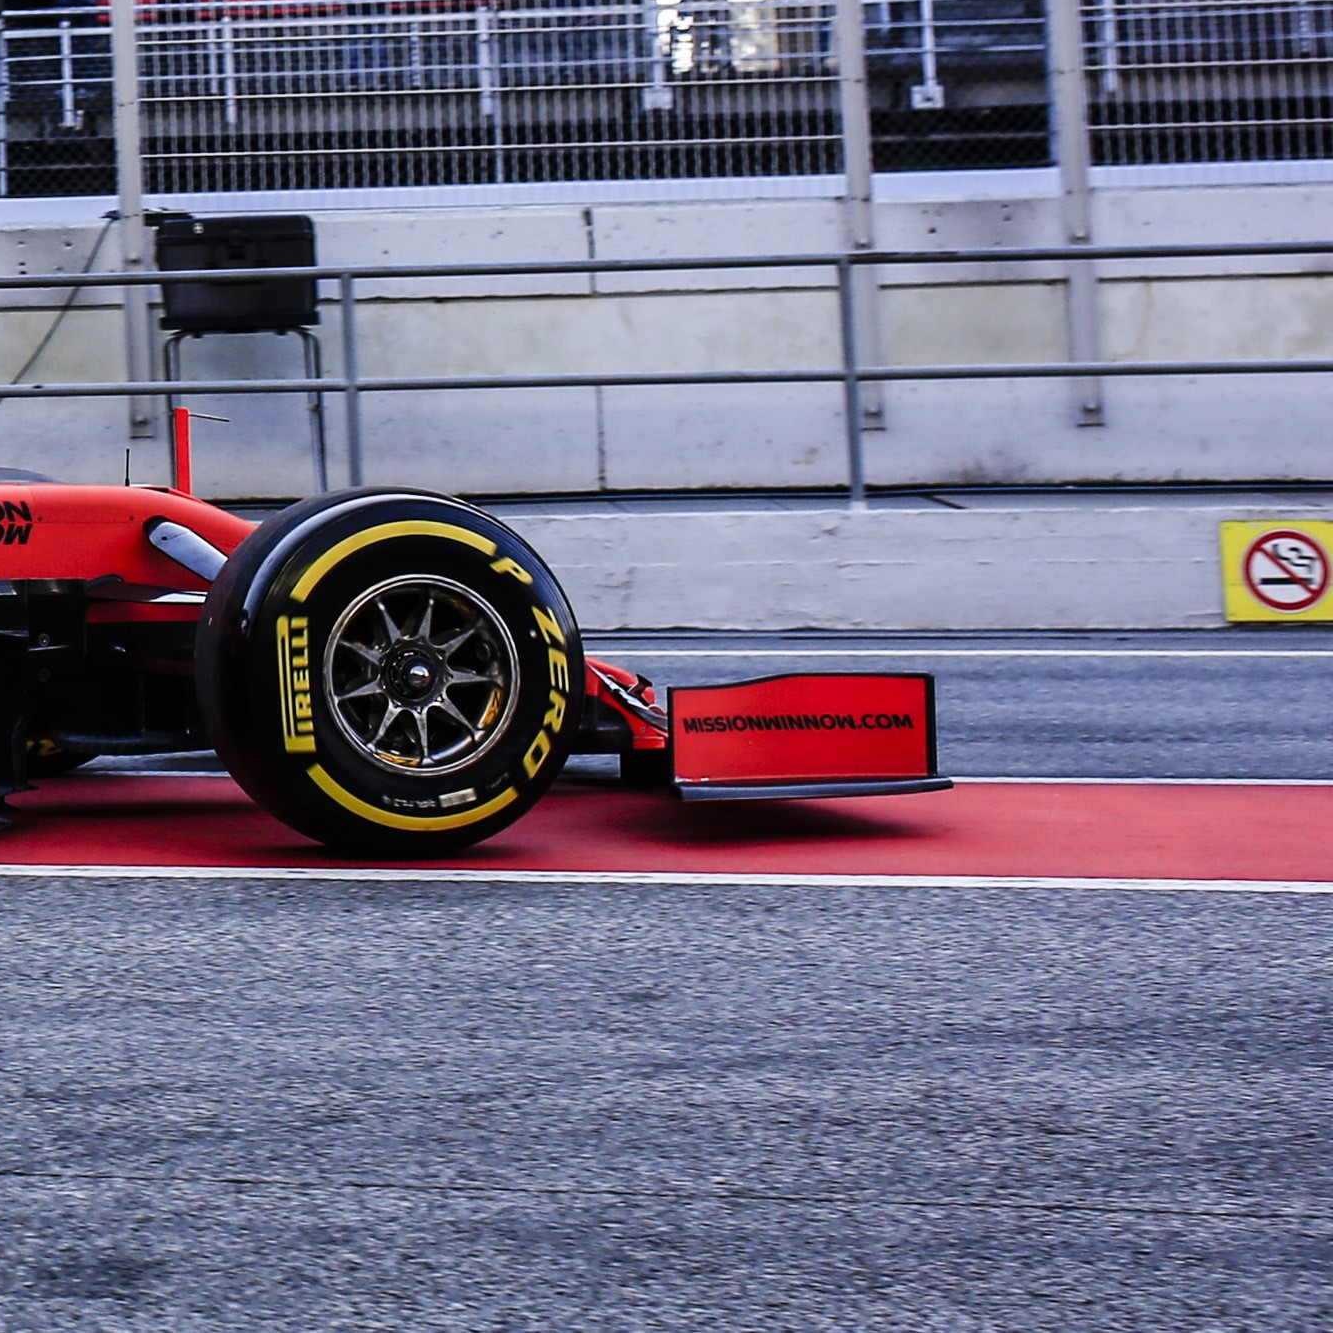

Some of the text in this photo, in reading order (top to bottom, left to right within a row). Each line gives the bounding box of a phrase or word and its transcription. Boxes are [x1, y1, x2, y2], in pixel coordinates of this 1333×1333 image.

[275, 614, 318, 754] PIRELLI
[522, 604, 572, 780] ZERO
[681, 713, 915, 735] MISSIONWINNOW.COM
